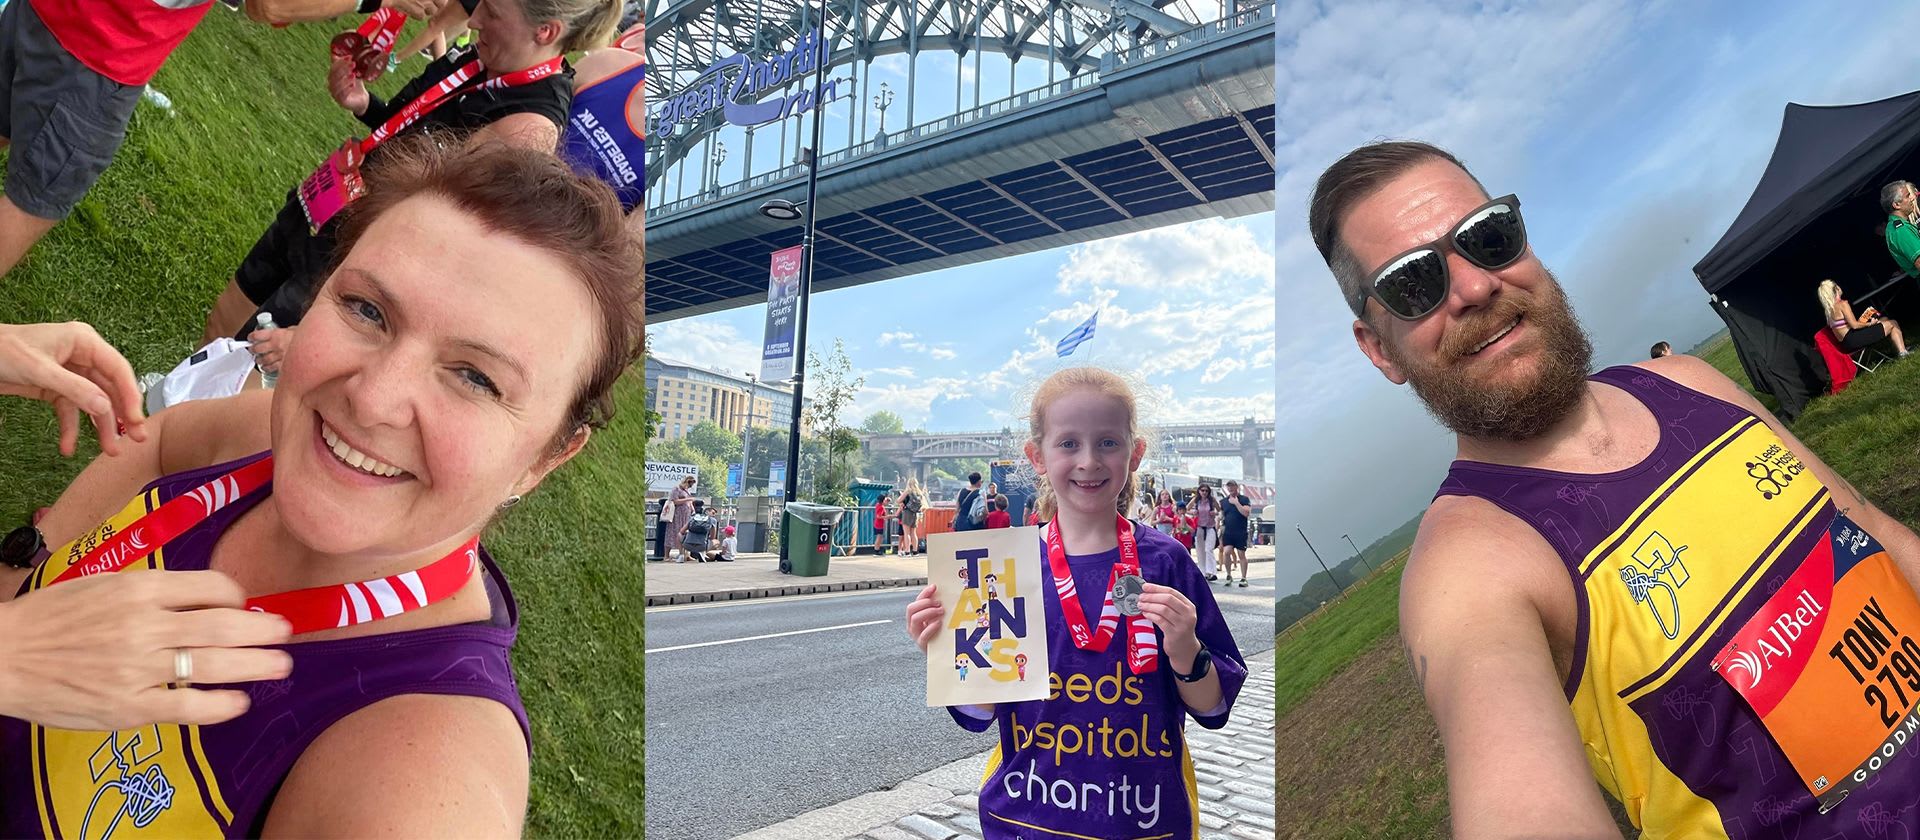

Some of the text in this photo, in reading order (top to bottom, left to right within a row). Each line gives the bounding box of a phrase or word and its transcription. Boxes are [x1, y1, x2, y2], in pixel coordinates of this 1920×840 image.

[657, 27, 830, 139] great north
[783, 79, 836, 120] run
[771, 305, 792, 318] STARTS
[645, 464, 696, 475] NEWCASTLE
[1755, 444, 1781, 462] Leeds
[1757, 589, 1824, 671] AJBell
[1828, 596, 1899, 685] TONY
[1048, 660, 1143, 705] eeds
[1853, 703, 1920, 782] GOODM
[1003, 758, 1161, 830] charity
